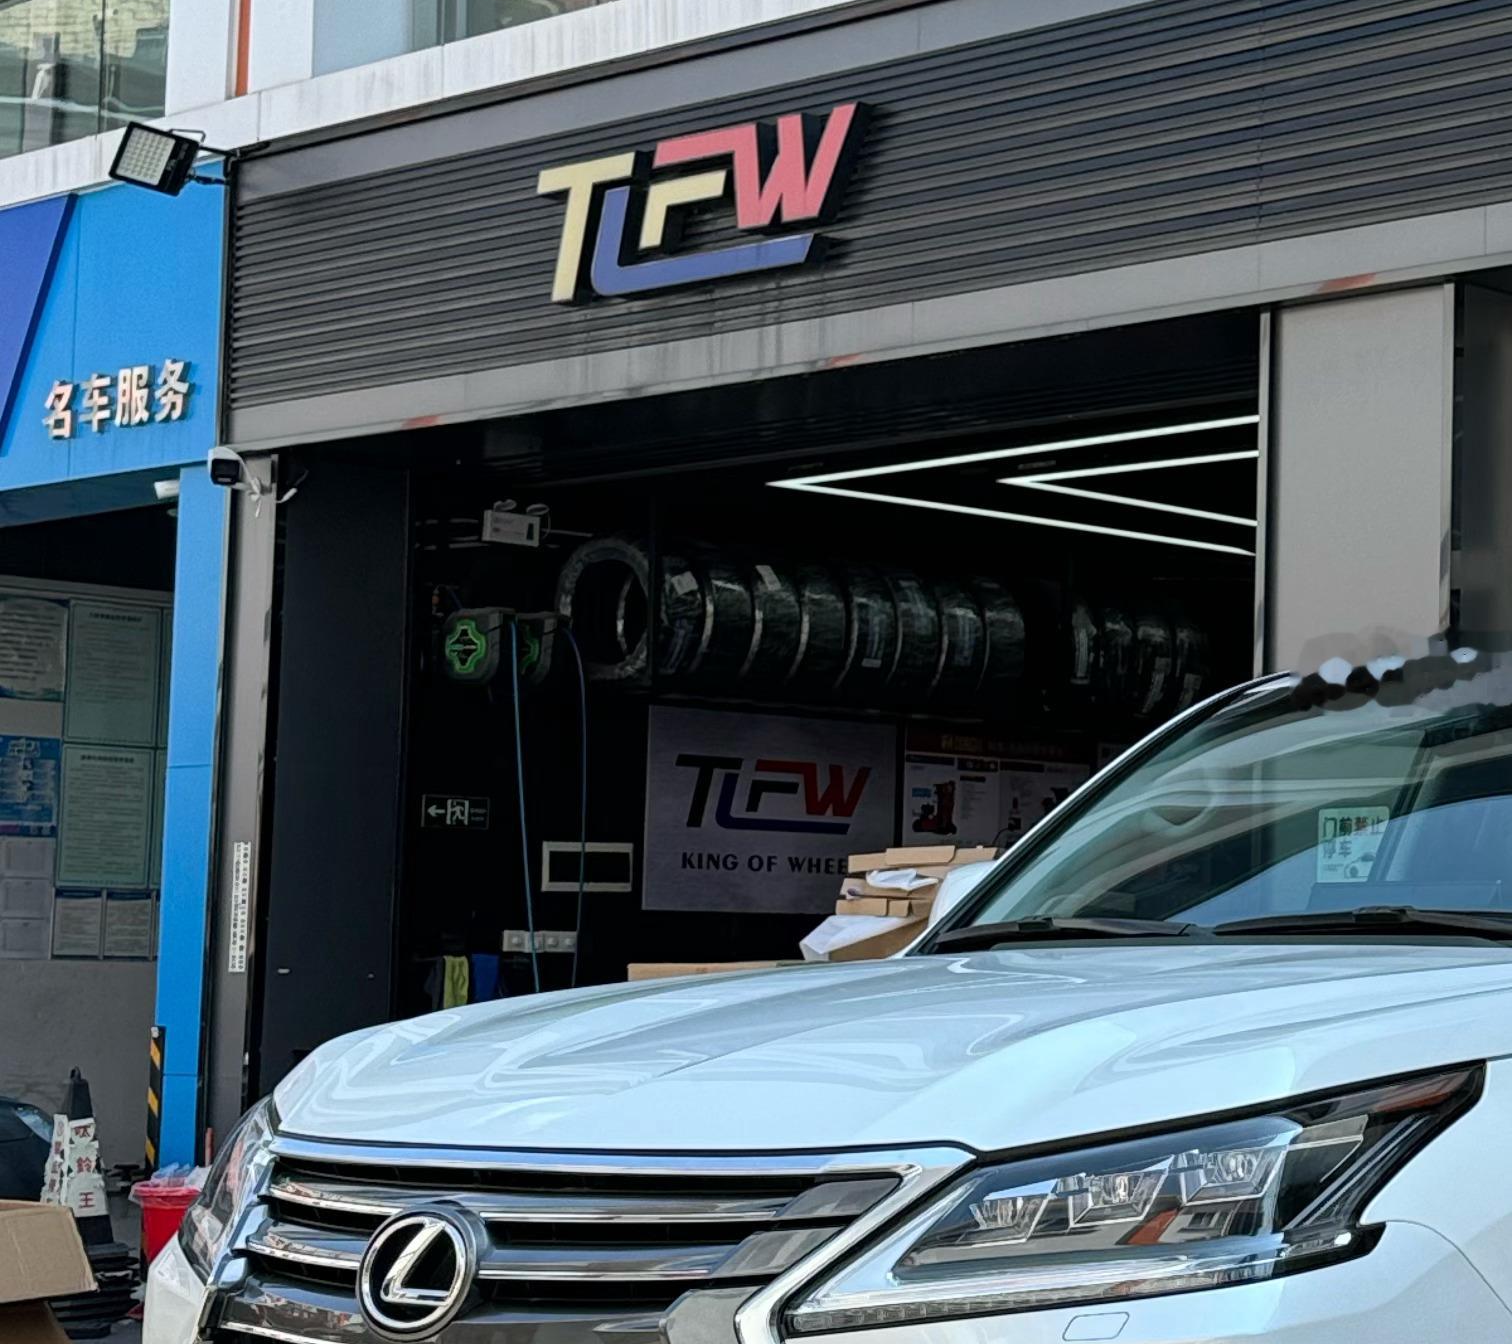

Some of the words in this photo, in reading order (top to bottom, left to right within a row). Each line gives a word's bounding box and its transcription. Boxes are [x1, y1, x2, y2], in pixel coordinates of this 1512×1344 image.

[42, 358, 189, 439] 名车服务
[681, 851, 739, 871] KING
[747, 854, 778, 873] OF
